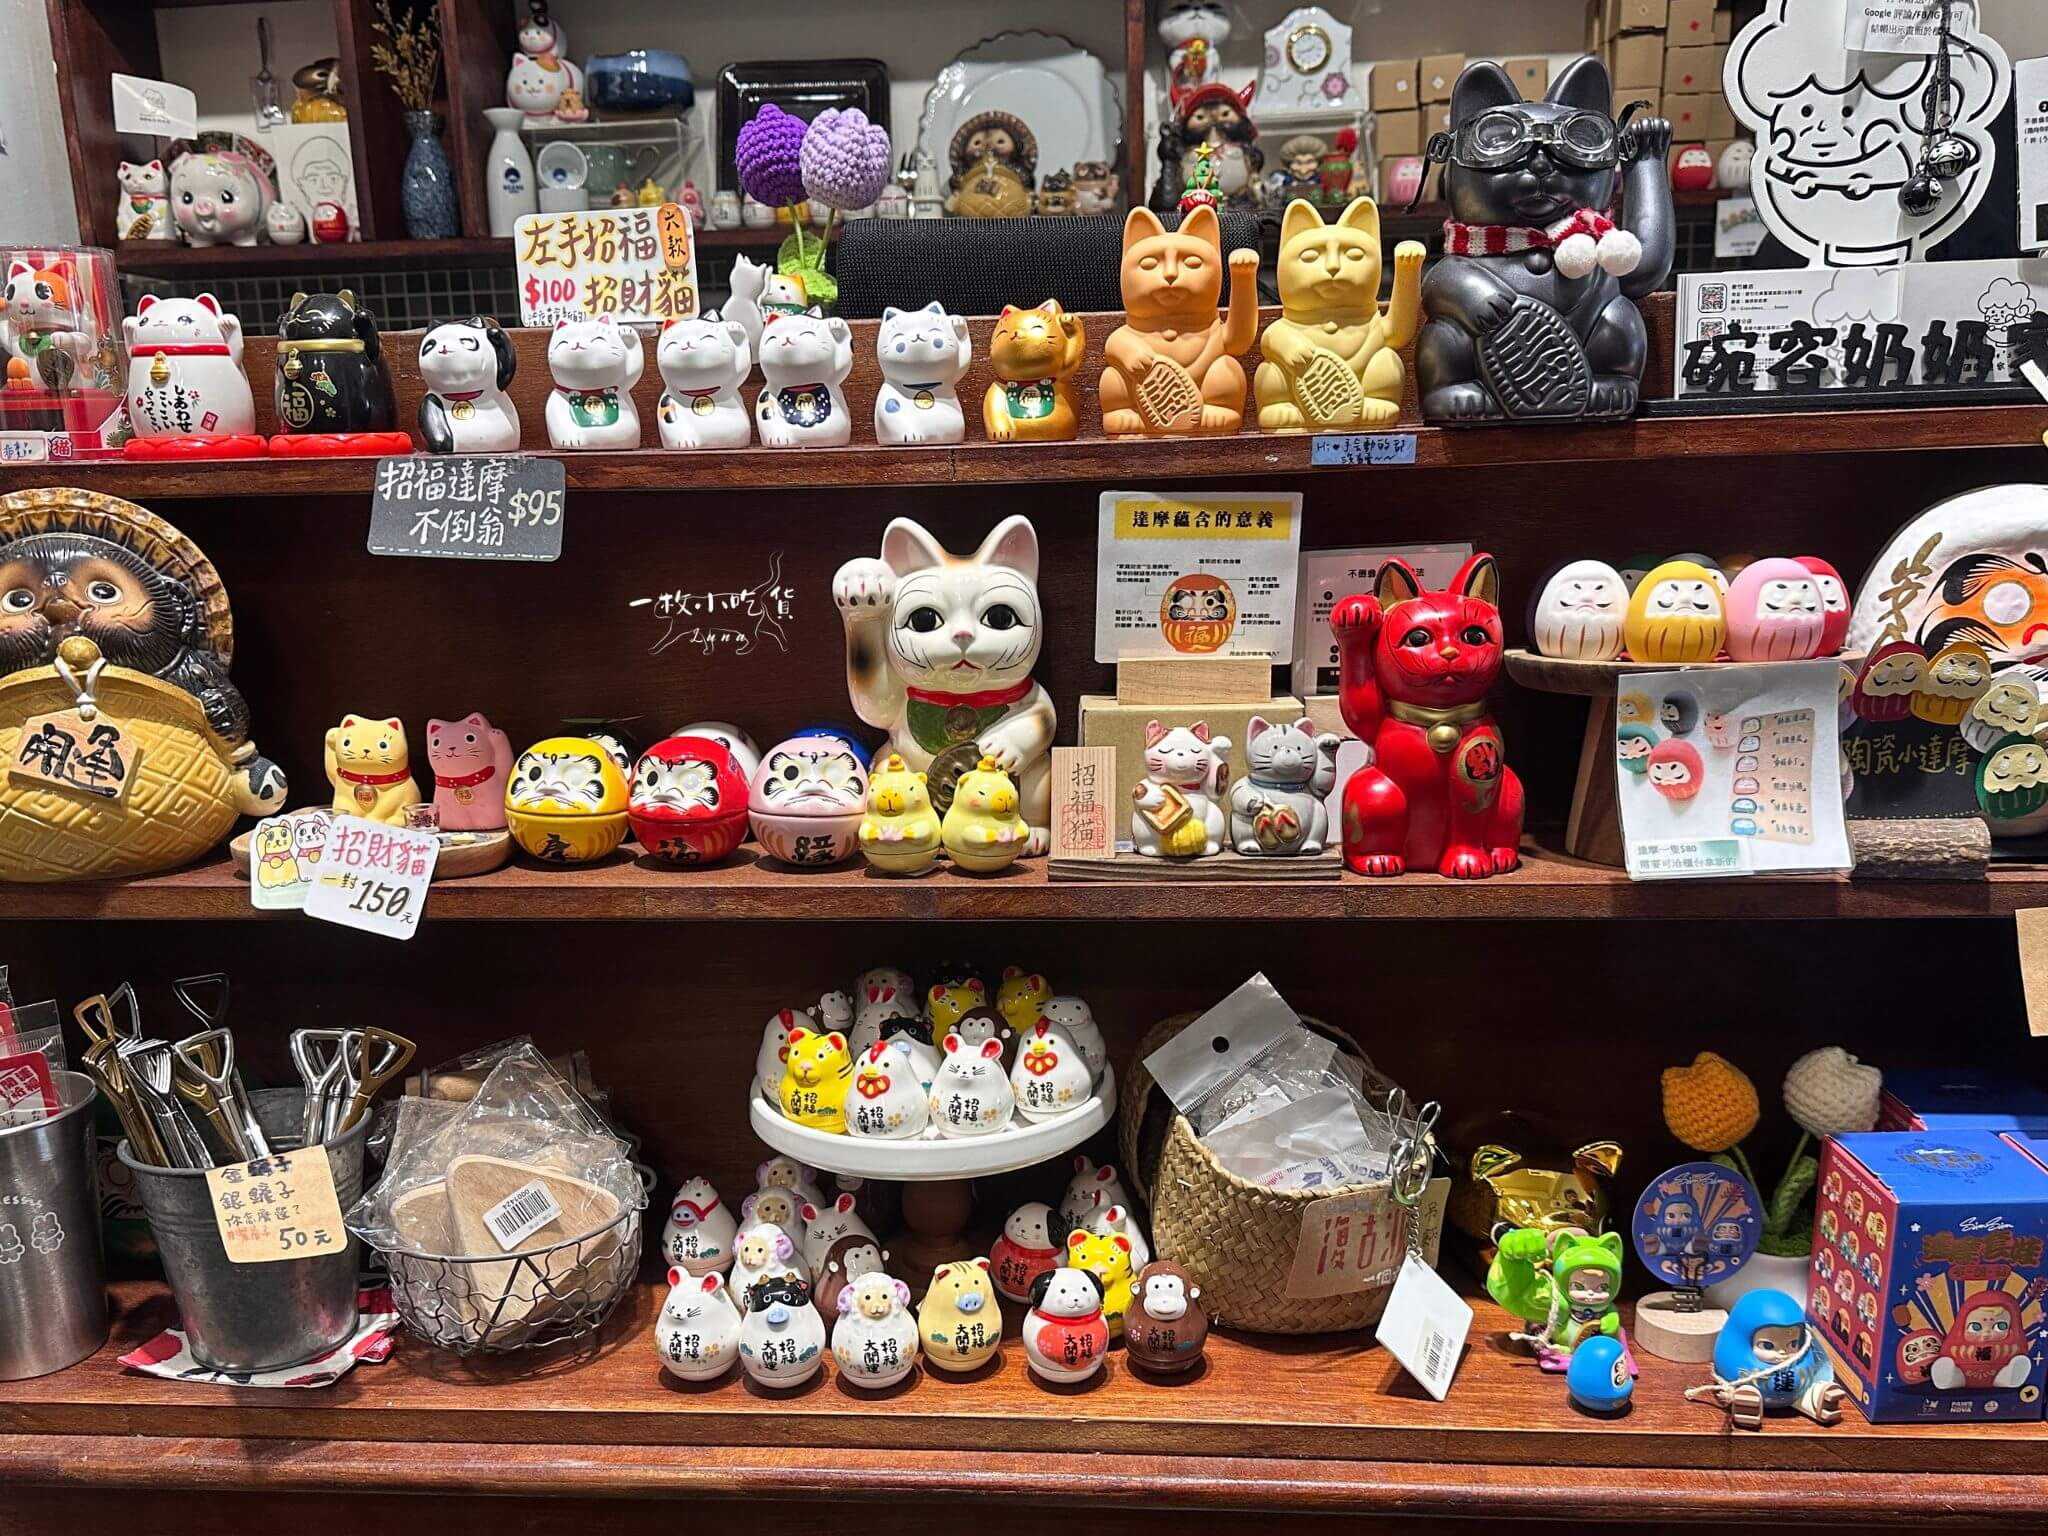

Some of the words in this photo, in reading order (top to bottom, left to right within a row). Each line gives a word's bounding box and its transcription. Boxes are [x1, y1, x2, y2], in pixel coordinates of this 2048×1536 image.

[1864, 8, 1892, 18] Google
[523, 211, 657, 269] 左手招福
[664, 211, 687, 259] 六款
[525, 274, 576, 311] $100
[583, 270, 694, 317] 招財貓
[174, 385, 193, 434] しあわせ
[283, 383, 311, 424] 福
[378, 459, 510, 505] 招福達摩
[409, 506, 505, 546] 不倒翁
[507, 487, 562, 528] $95
[1132, 510, 1274, 529] 達摩蘊含的意義
[1185, 625, 1211, 643] 福
[1841, 732, 1972, 776] 陶瓷小達摩
[332, 825, 431, 877] 招財貓
[322, 872, 360, 890] 一對
[279, 1226, 333, 1251] 50元
